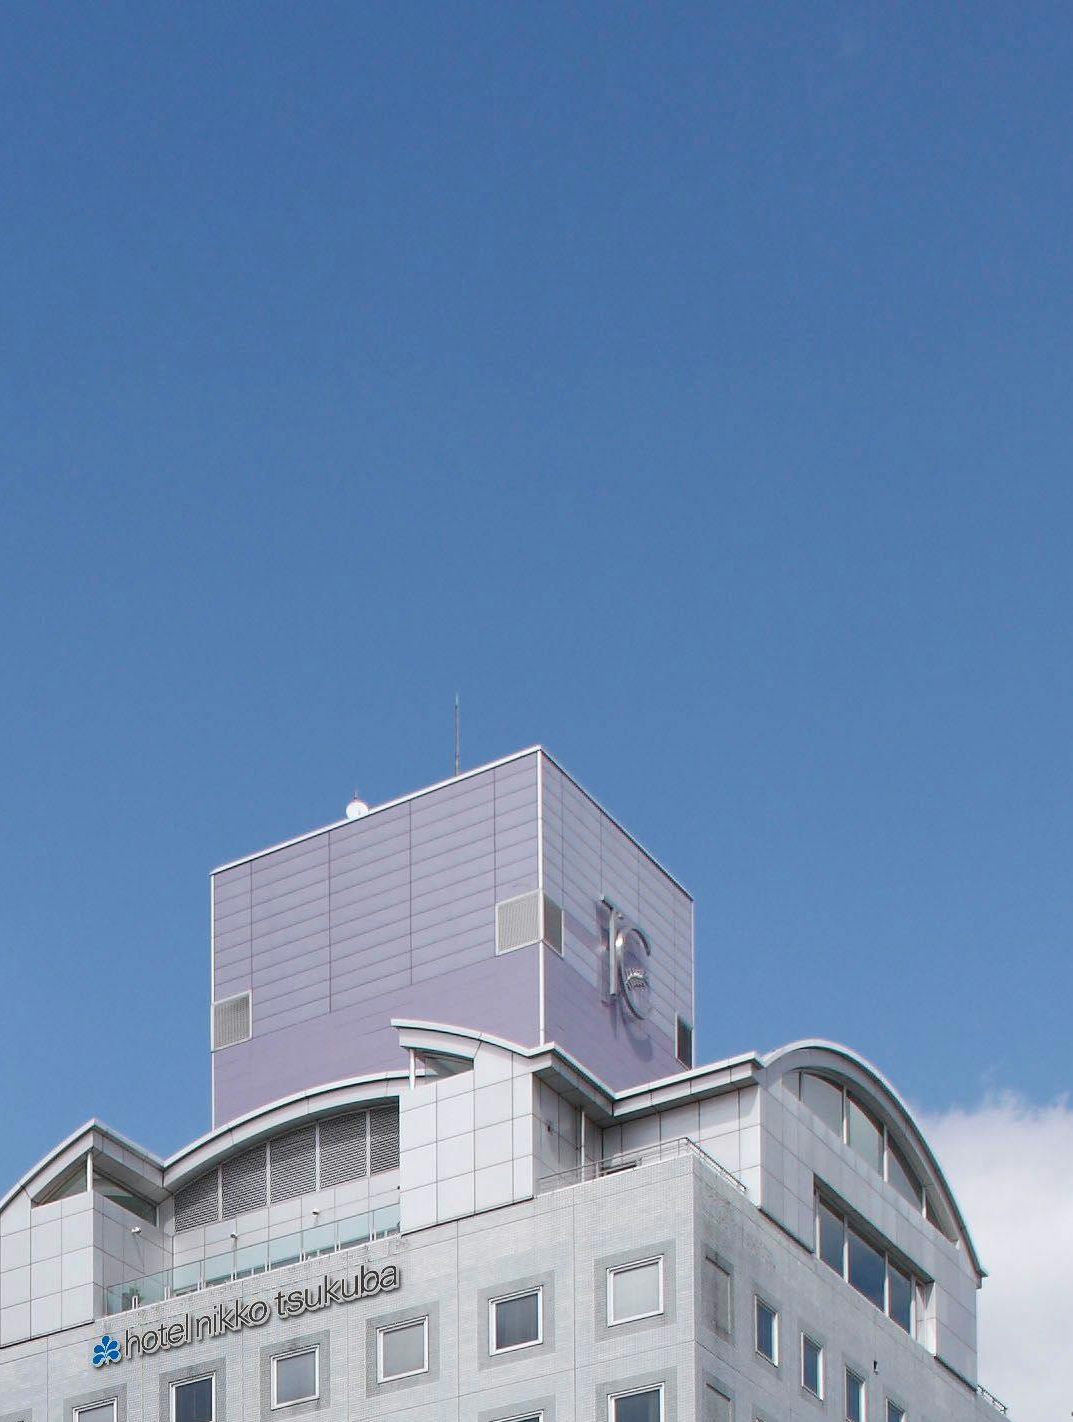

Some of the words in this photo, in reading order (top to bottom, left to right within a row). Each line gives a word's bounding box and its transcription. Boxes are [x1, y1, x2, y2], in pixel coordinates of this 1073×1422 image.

[125, 1313, 190, 1358] hotel
[195, 1299, 271, 1341] nikko
[275, 1264, 403, 1318] tsukuba
